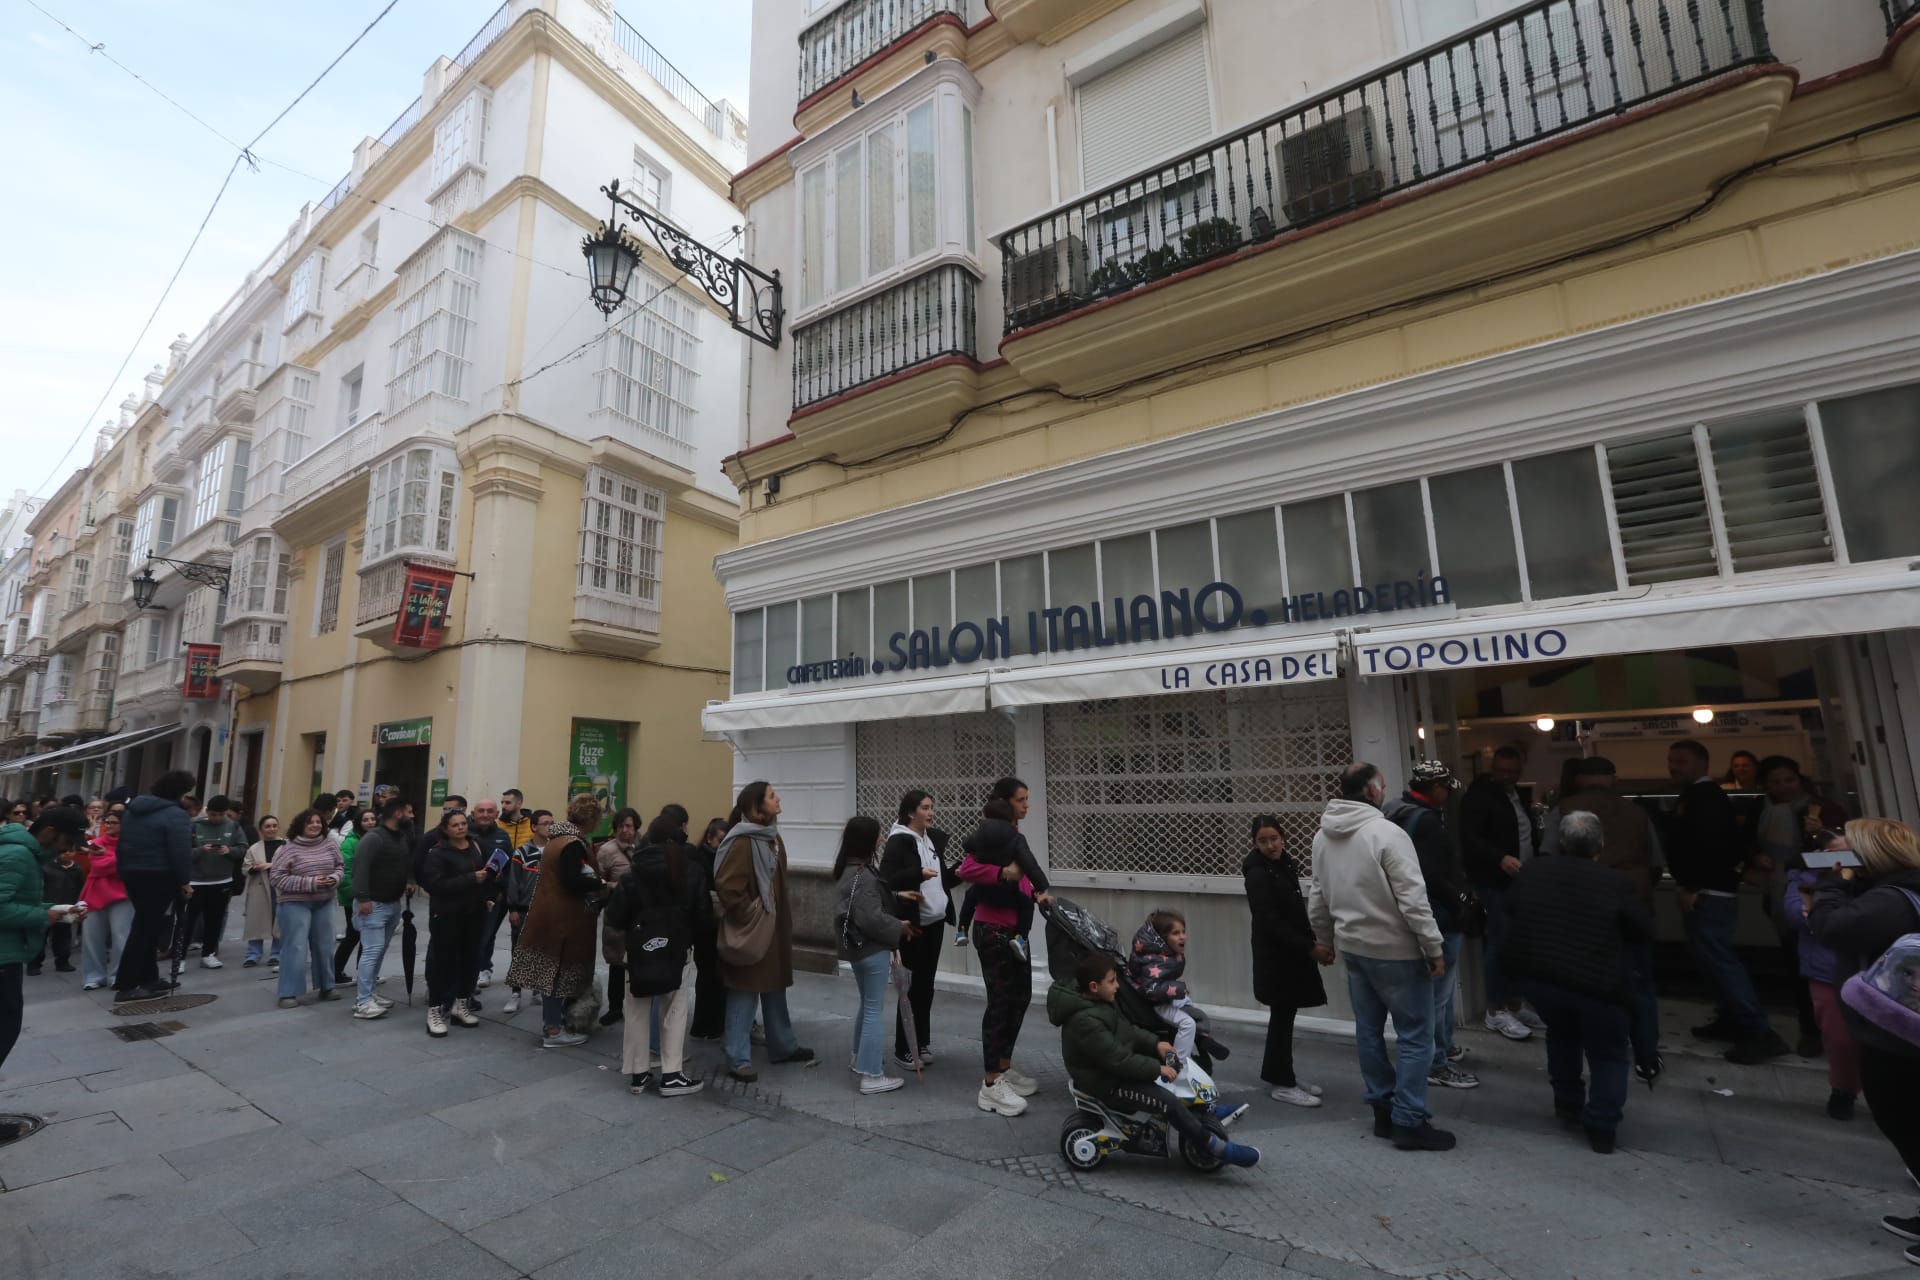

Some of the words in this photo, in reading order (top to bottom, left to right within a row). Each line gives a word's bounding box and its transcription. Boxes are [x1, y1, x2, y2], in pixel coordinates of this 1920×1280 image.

[787, 652, 865, 684] CAFETERÍA
[888, 615, 1010, 672] SALON
[1028, 582, 1243, 655] ITALIANO
[1282, 570, 1450, 623] HELADERÍA
[1162, 666, 1189, 690] LA
[1205, 658, 1272, 687] CASA
[1282, 653, 1333, 680] DEL
[1363, 629, 1567, 673] TOPOLINO
[579, 742, 604, 756] fuze
[579, 755, 598, 766] tea
